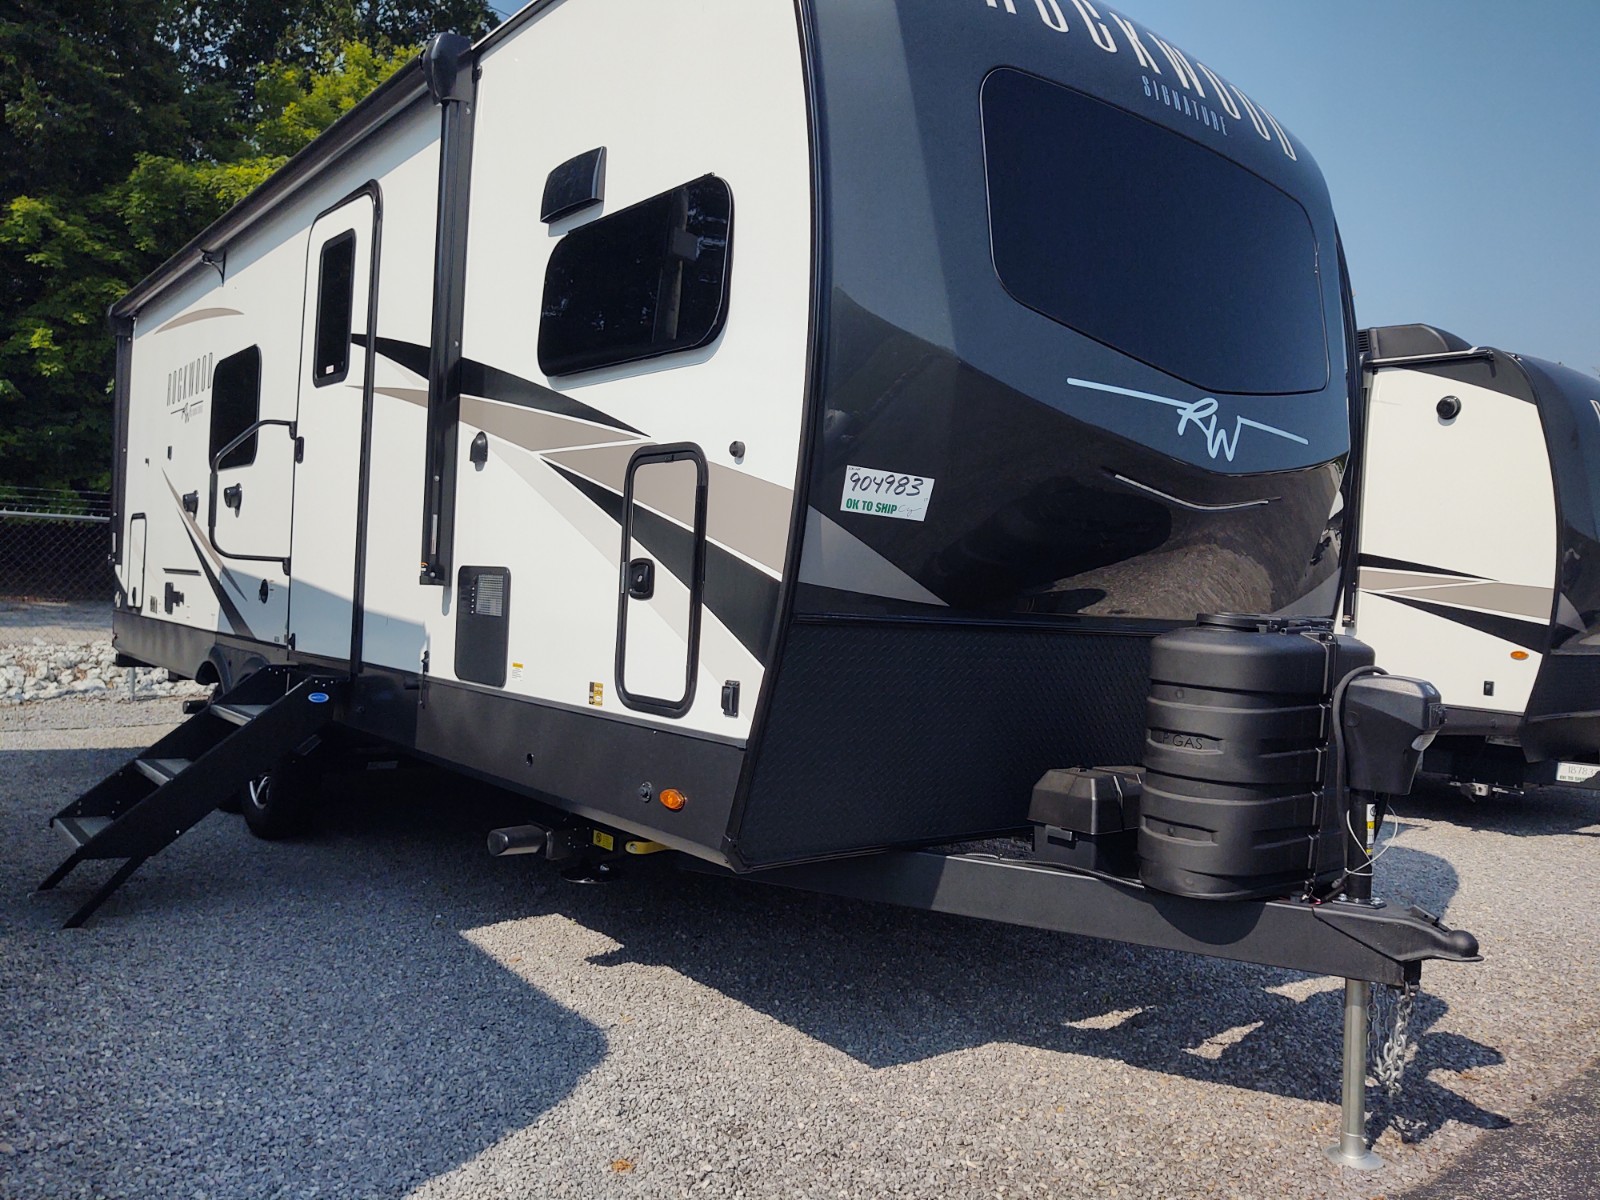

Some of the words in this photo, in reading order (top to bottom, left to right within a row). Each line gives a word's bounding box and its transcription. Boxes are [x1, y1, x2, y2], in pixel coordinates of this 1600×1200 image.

[986, 0, 1298, 162] OCKWOOD
[1141, 75, 1228, 136] SIGNATURE
[166, 352, 213, 407] ROCKWOOD
[849, 472, 924, 496] 904983
[846, 498, 860, 510] OK
[862, 500, 873, 511] TO
[875, 502, 898, 514] SHIP
[1172, 734, 1203, 750] GAS
